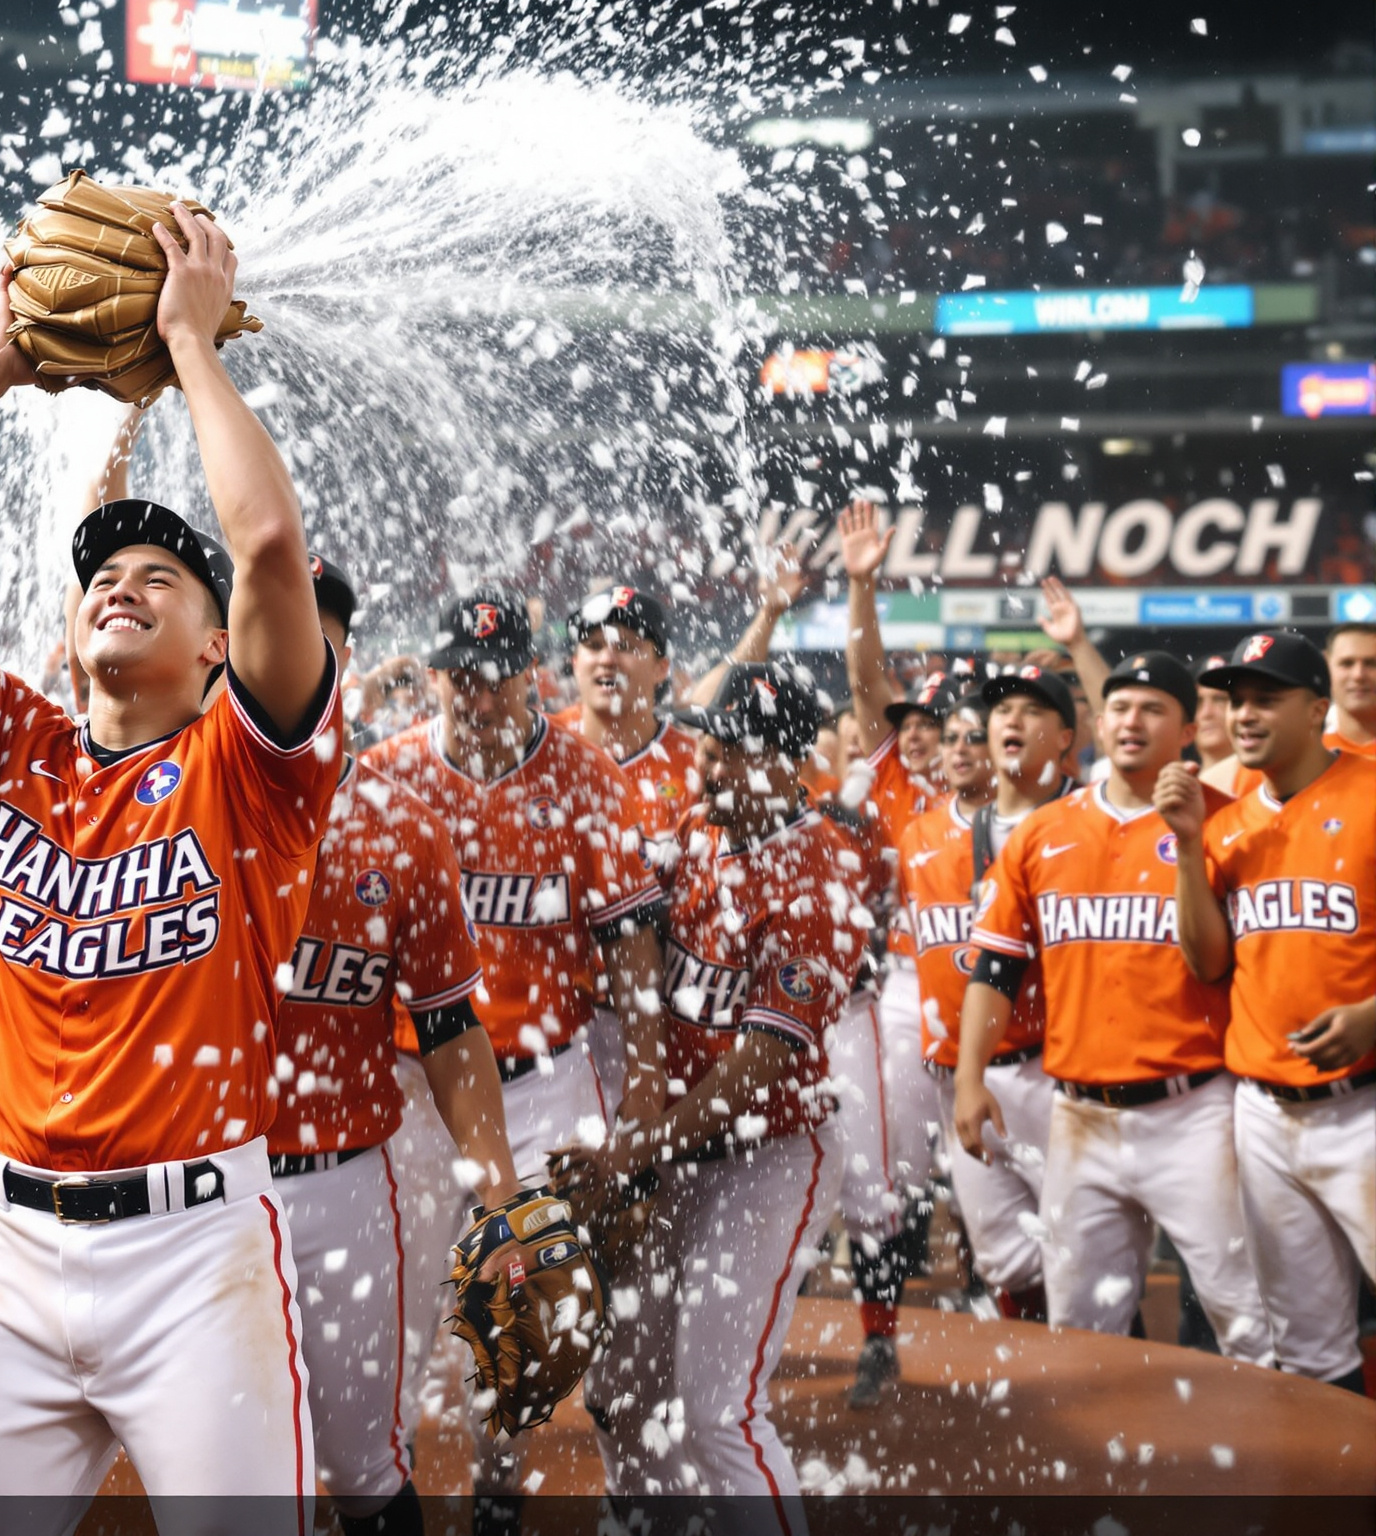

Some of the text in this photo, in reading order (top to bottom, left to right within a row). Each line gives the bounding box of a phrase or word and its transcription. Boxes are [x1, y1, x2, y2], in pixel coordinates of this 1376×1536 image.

[1025, 500, 1322, 578] NOCH
[1226, 879, 1360, 936] AGLES
[285, 934, 391, 1007] LES
